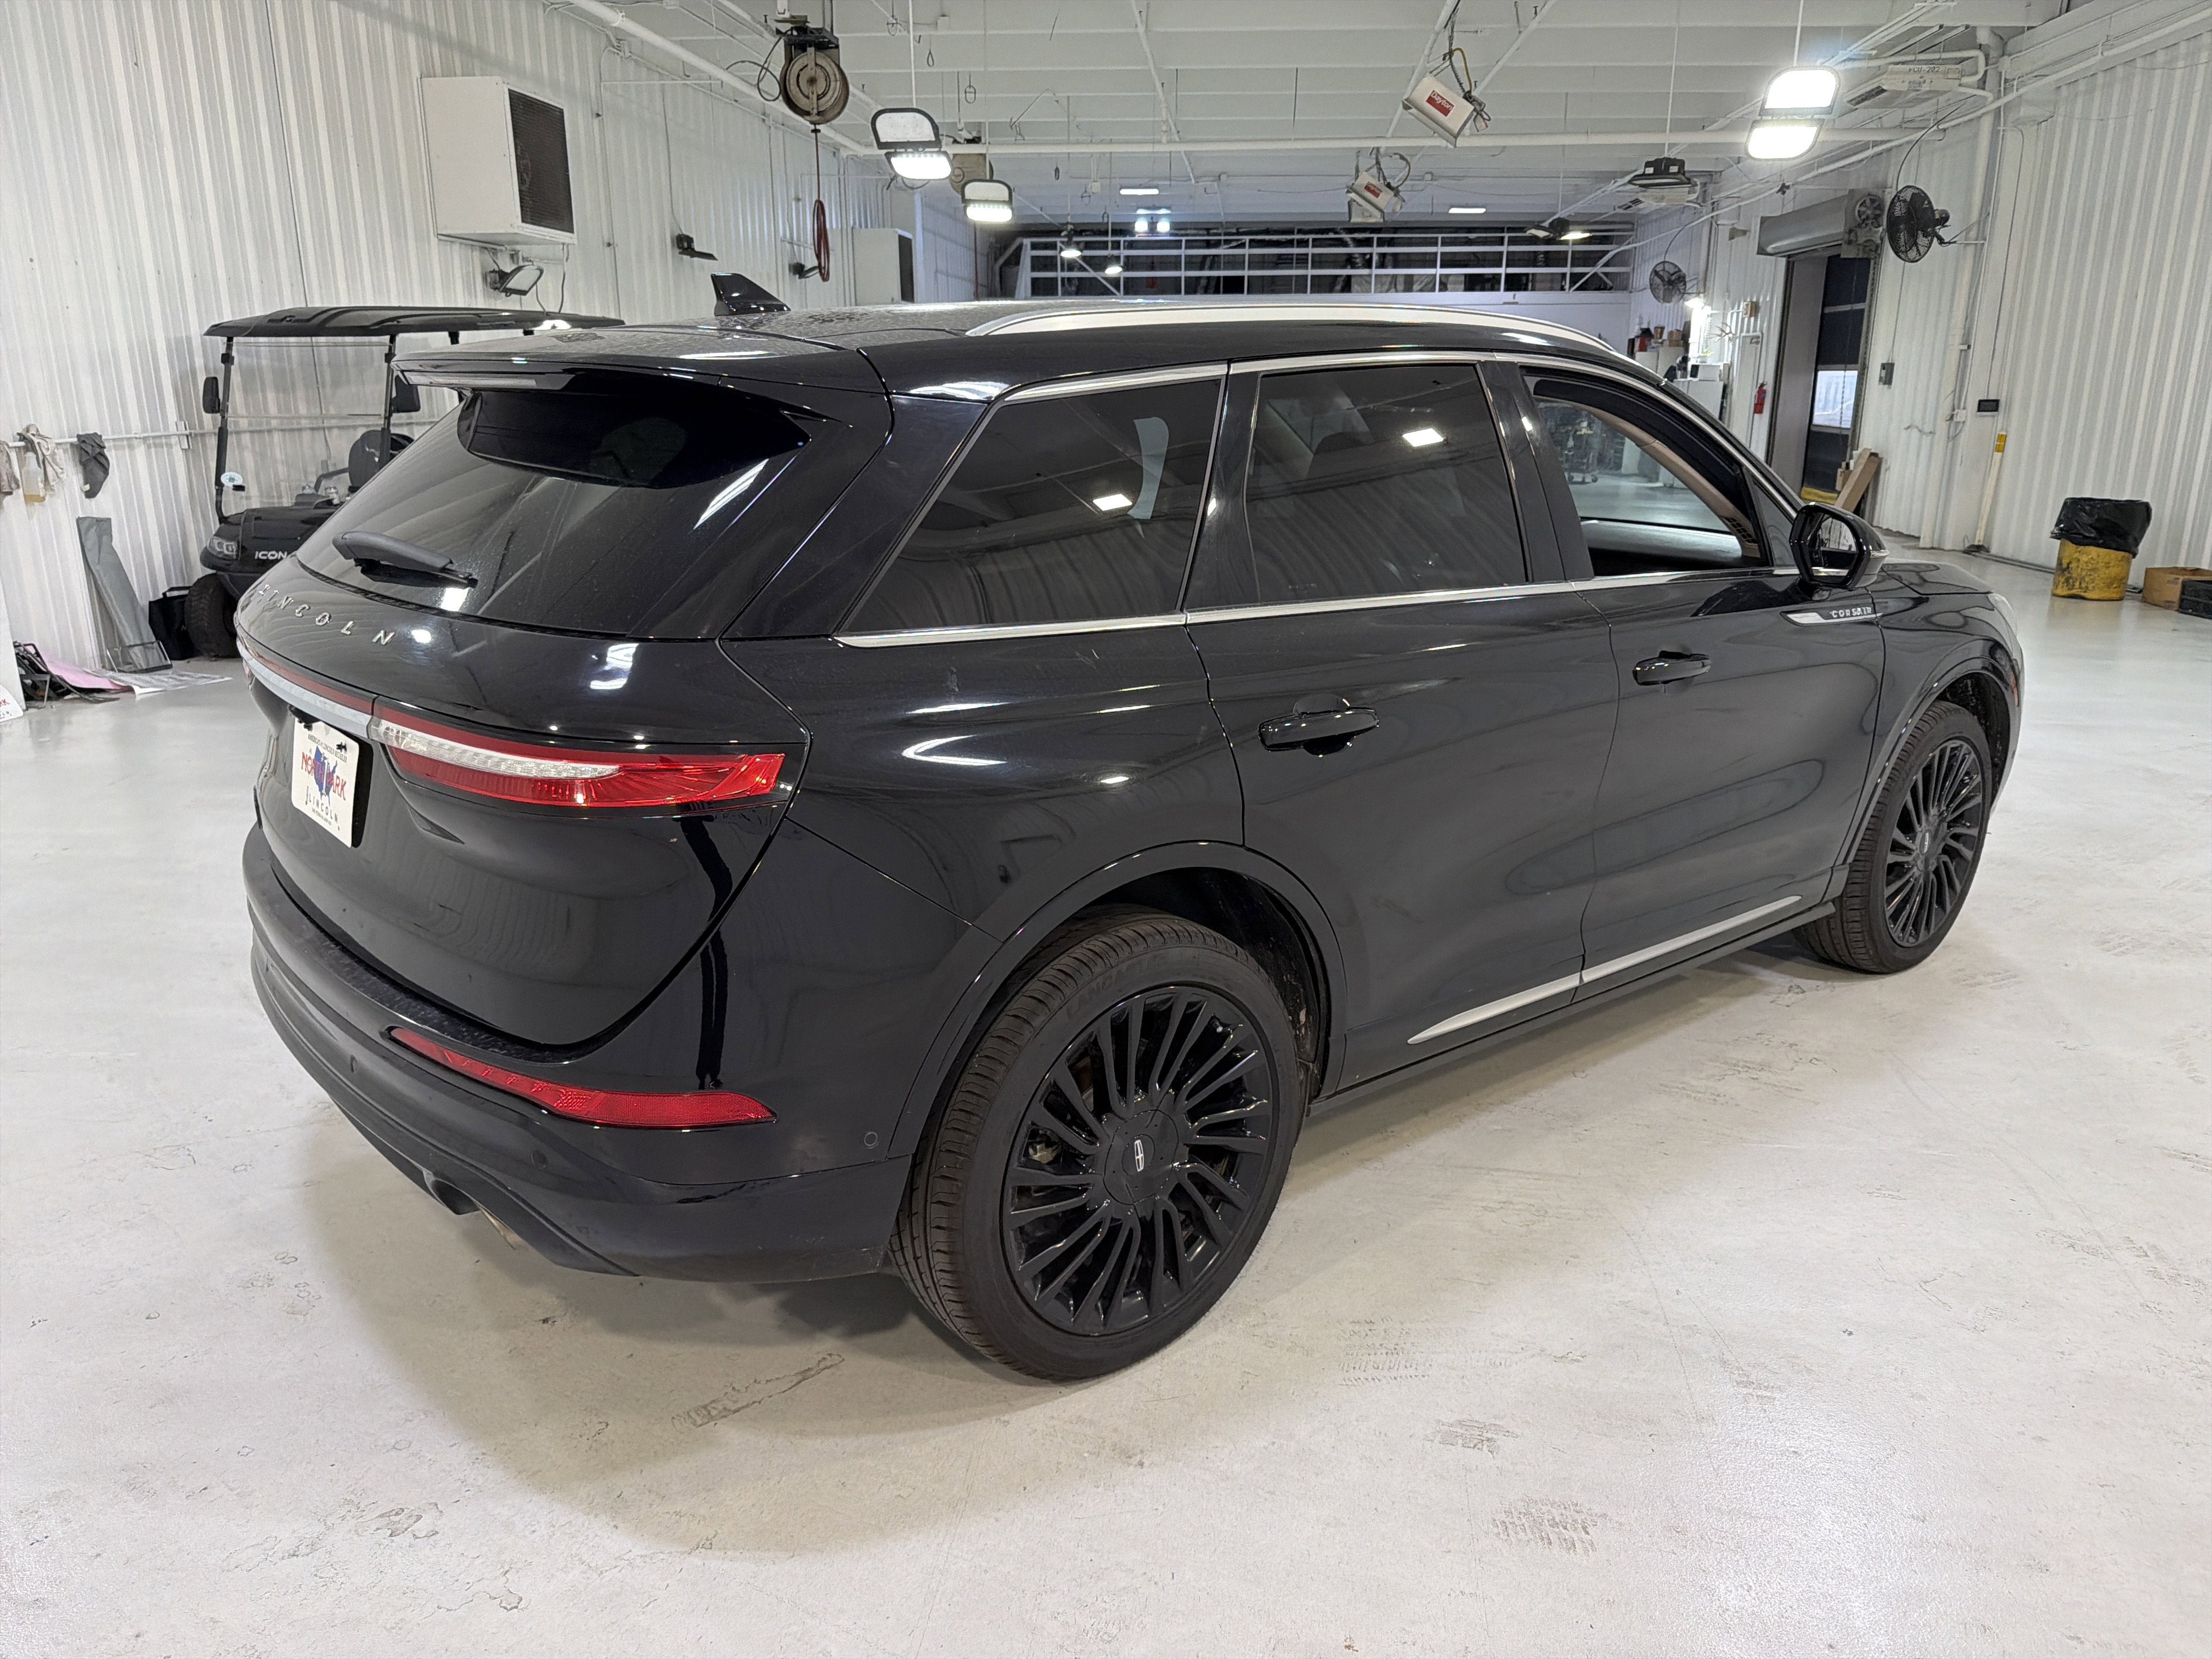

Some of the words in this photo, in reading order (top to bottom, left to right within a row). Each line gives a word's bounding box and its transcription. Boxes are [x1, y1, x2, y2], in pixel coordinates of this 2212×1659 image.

[1430, 91, 1453, 111] Dayton
[254, 550, 288, 560] ICON
[1831, 606, 1872, 618] CORSAIR
[301, 751, 325, 783] NORTH
[326, 769, 347, 801] PARK
[309, 793, 338, 823] LINCOLN
